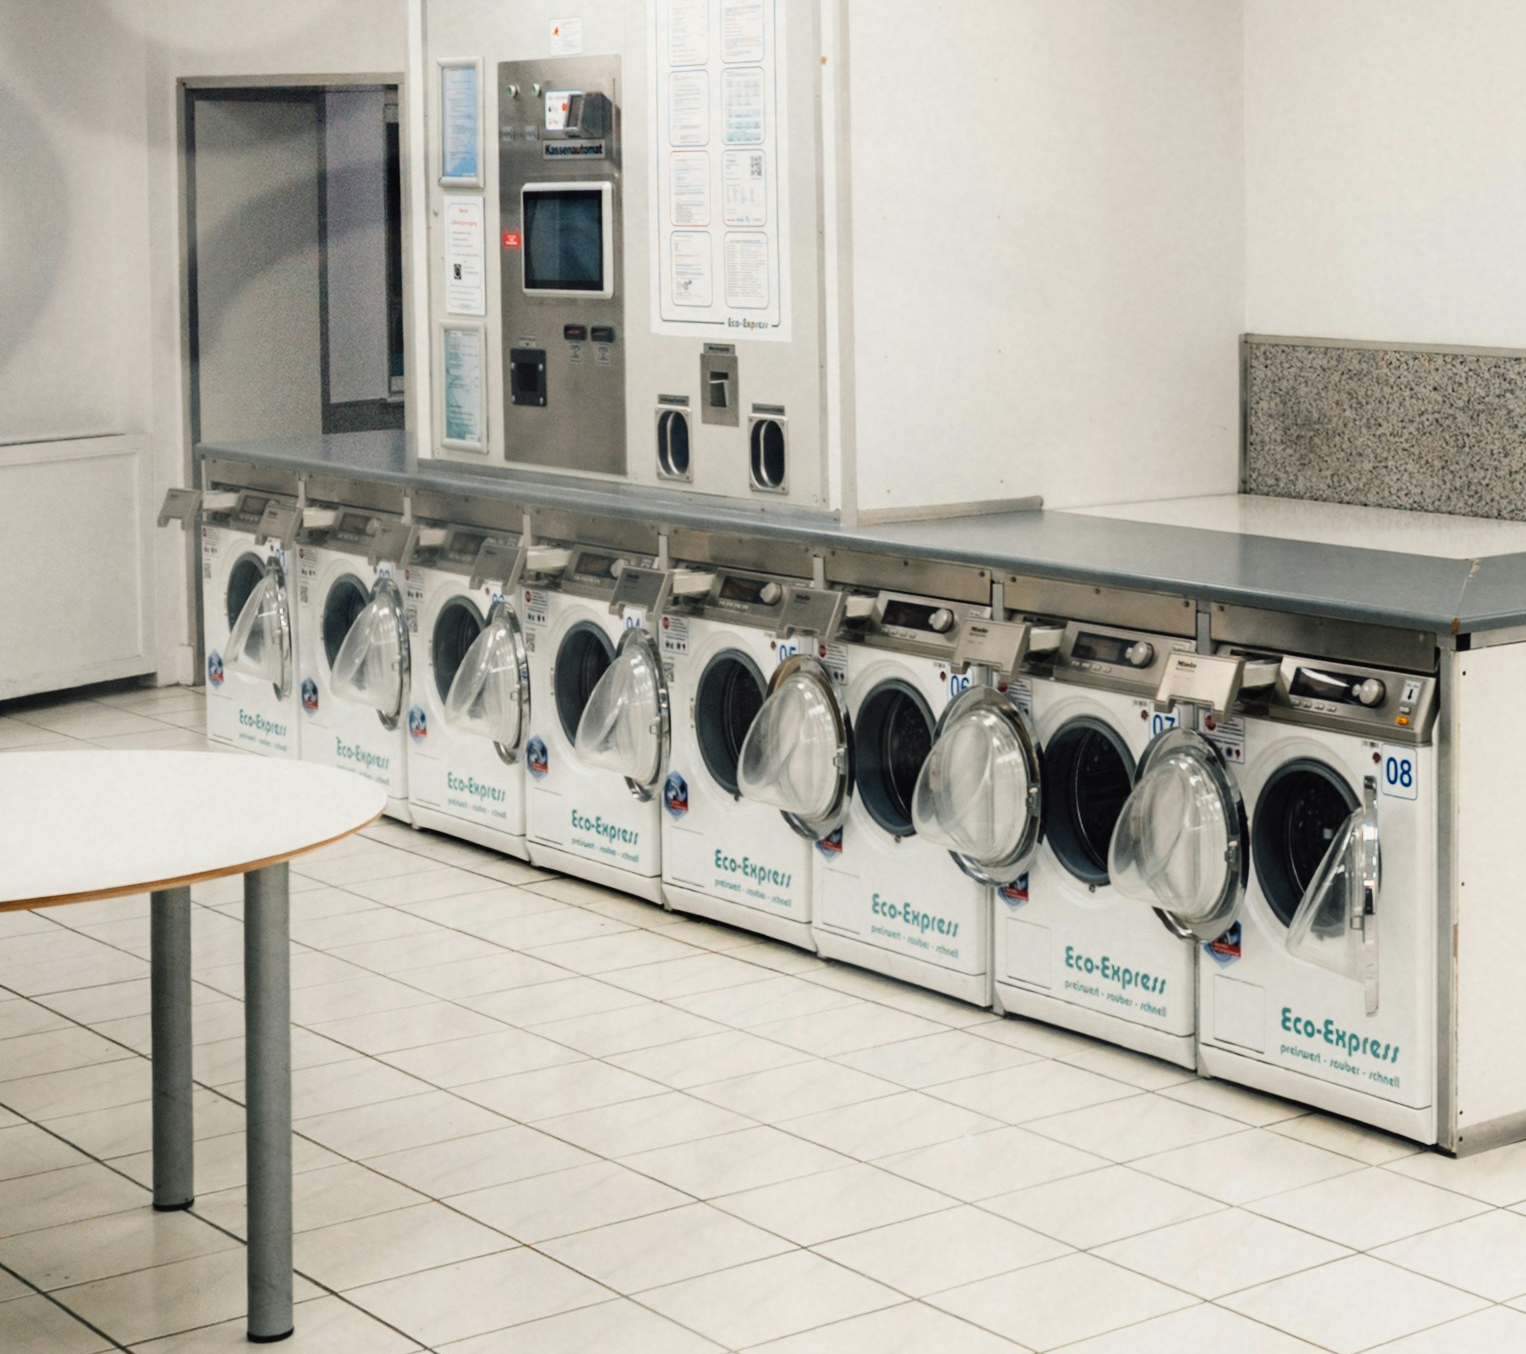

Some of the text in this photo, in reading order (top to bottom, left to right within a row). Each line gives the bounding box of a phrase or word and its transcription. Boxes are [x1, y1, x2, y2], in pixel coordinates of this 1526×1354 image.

[545, 144, 603, 156] Kassenautomat
[727, 317, 769, 331] Eco-Express
[239, 708, 287, 737] Eco-Express
[337, 738, 390, 770] Eco-Express
[447, 771, 506, 802] Eco-Express
[1386, 756, 1412, 788] 08
[572, 809, 639, 846] Eco-Express
[715, 849, 792, 888] Eco-Express
[871, 893, 960, 937] Eco-Express
[1064, 945, 1167, 995] Eco-Express
[1140, 1002, 1167, 1017] schnell
[1281, 1007, 1400, 1063] Eco-Express
[1280, 1044, 1322, 1063] preiswert
[1329, 1058, 1360, 1075] sauber
[1368, 1071, 1400, 1088] schnell
